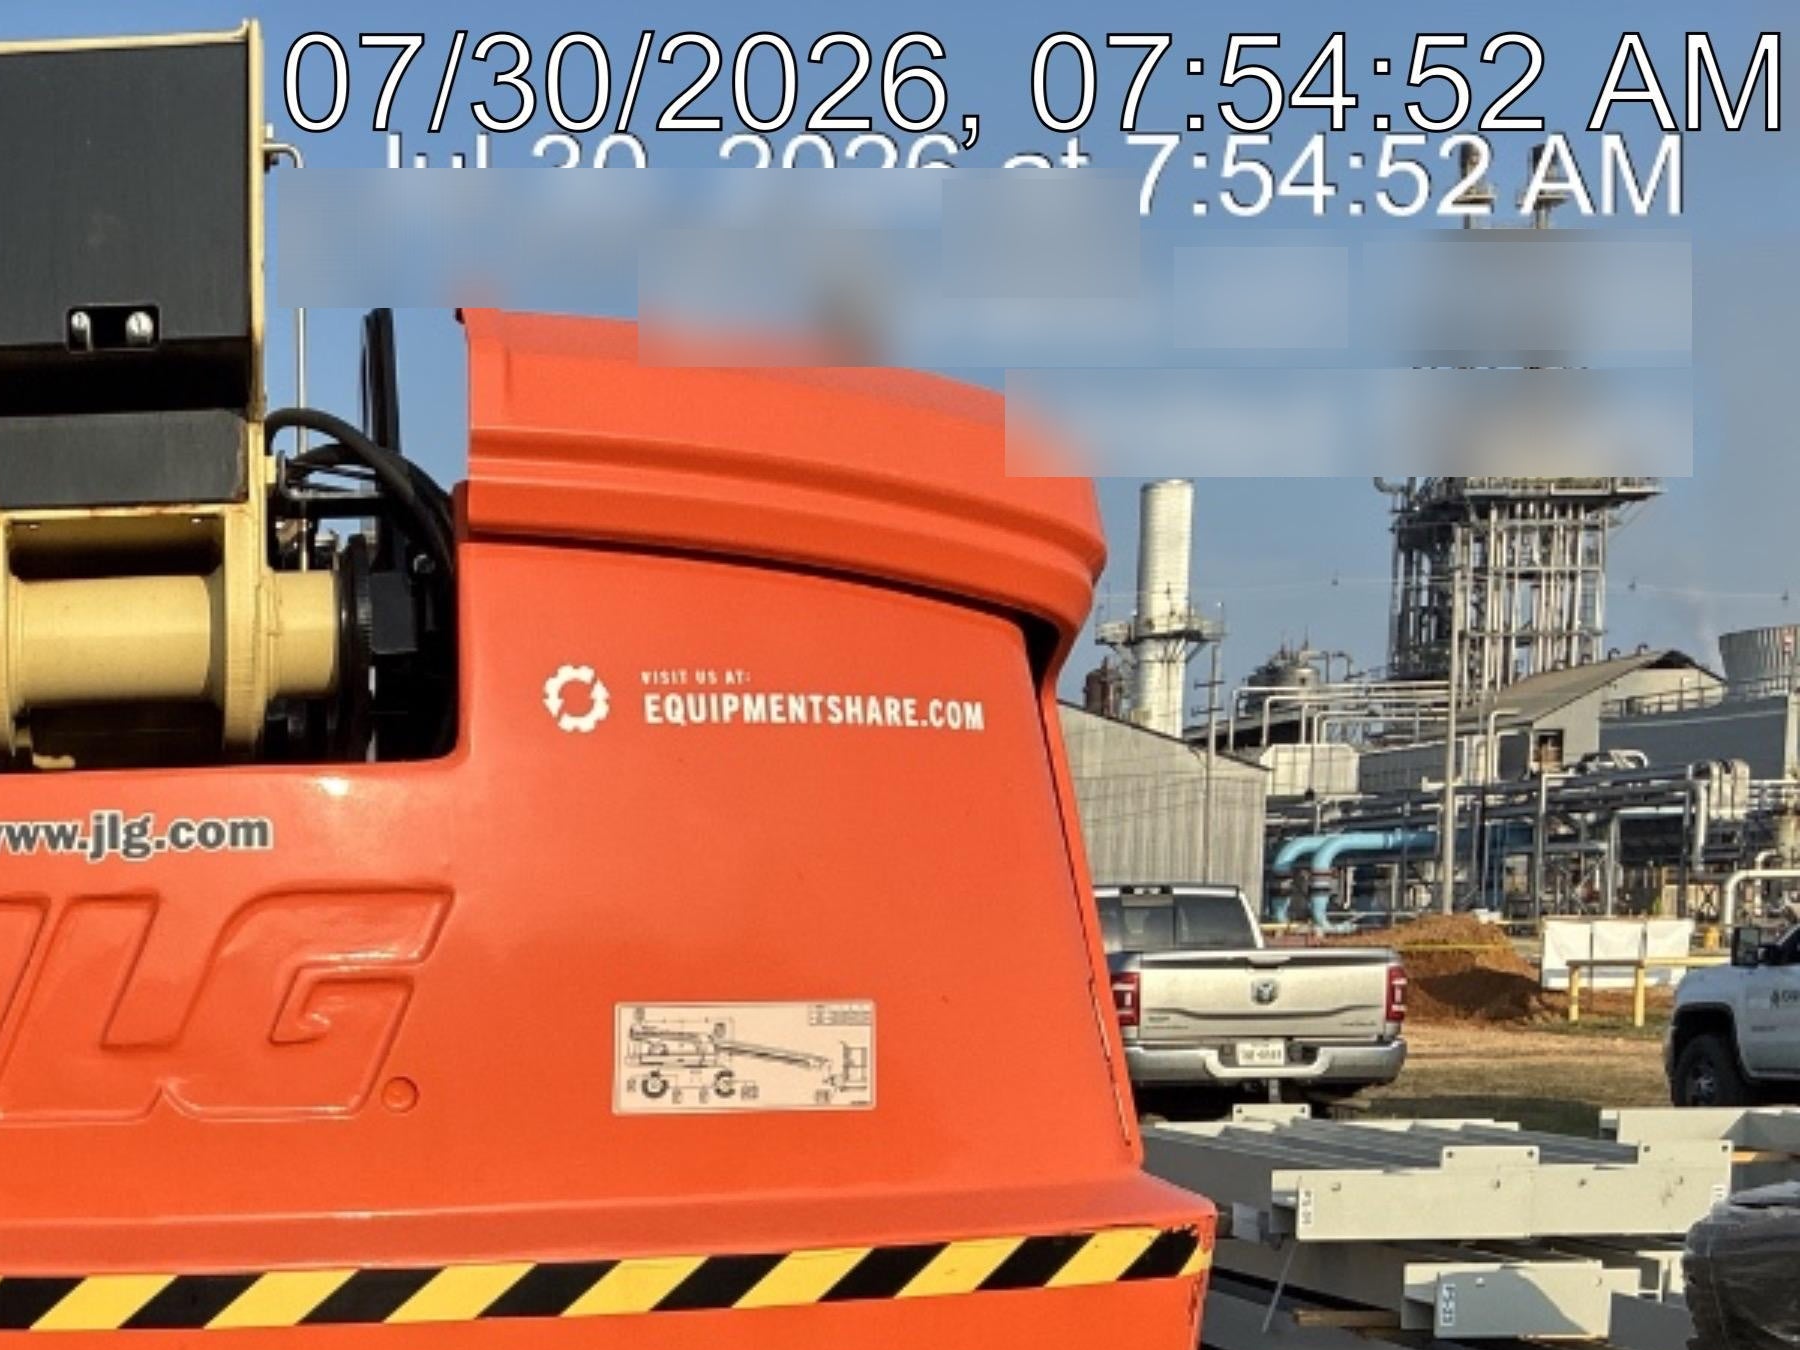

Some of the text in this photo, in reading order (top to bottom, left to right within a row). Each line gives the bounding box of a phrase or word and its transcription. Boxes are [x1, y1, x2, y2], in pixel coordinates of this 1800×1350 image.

[641, 671, 688, 684] VISIT
[696, 671, 717, 684] US
[643, 692, 985, 731] EQUIPMENTSHARE.COM
